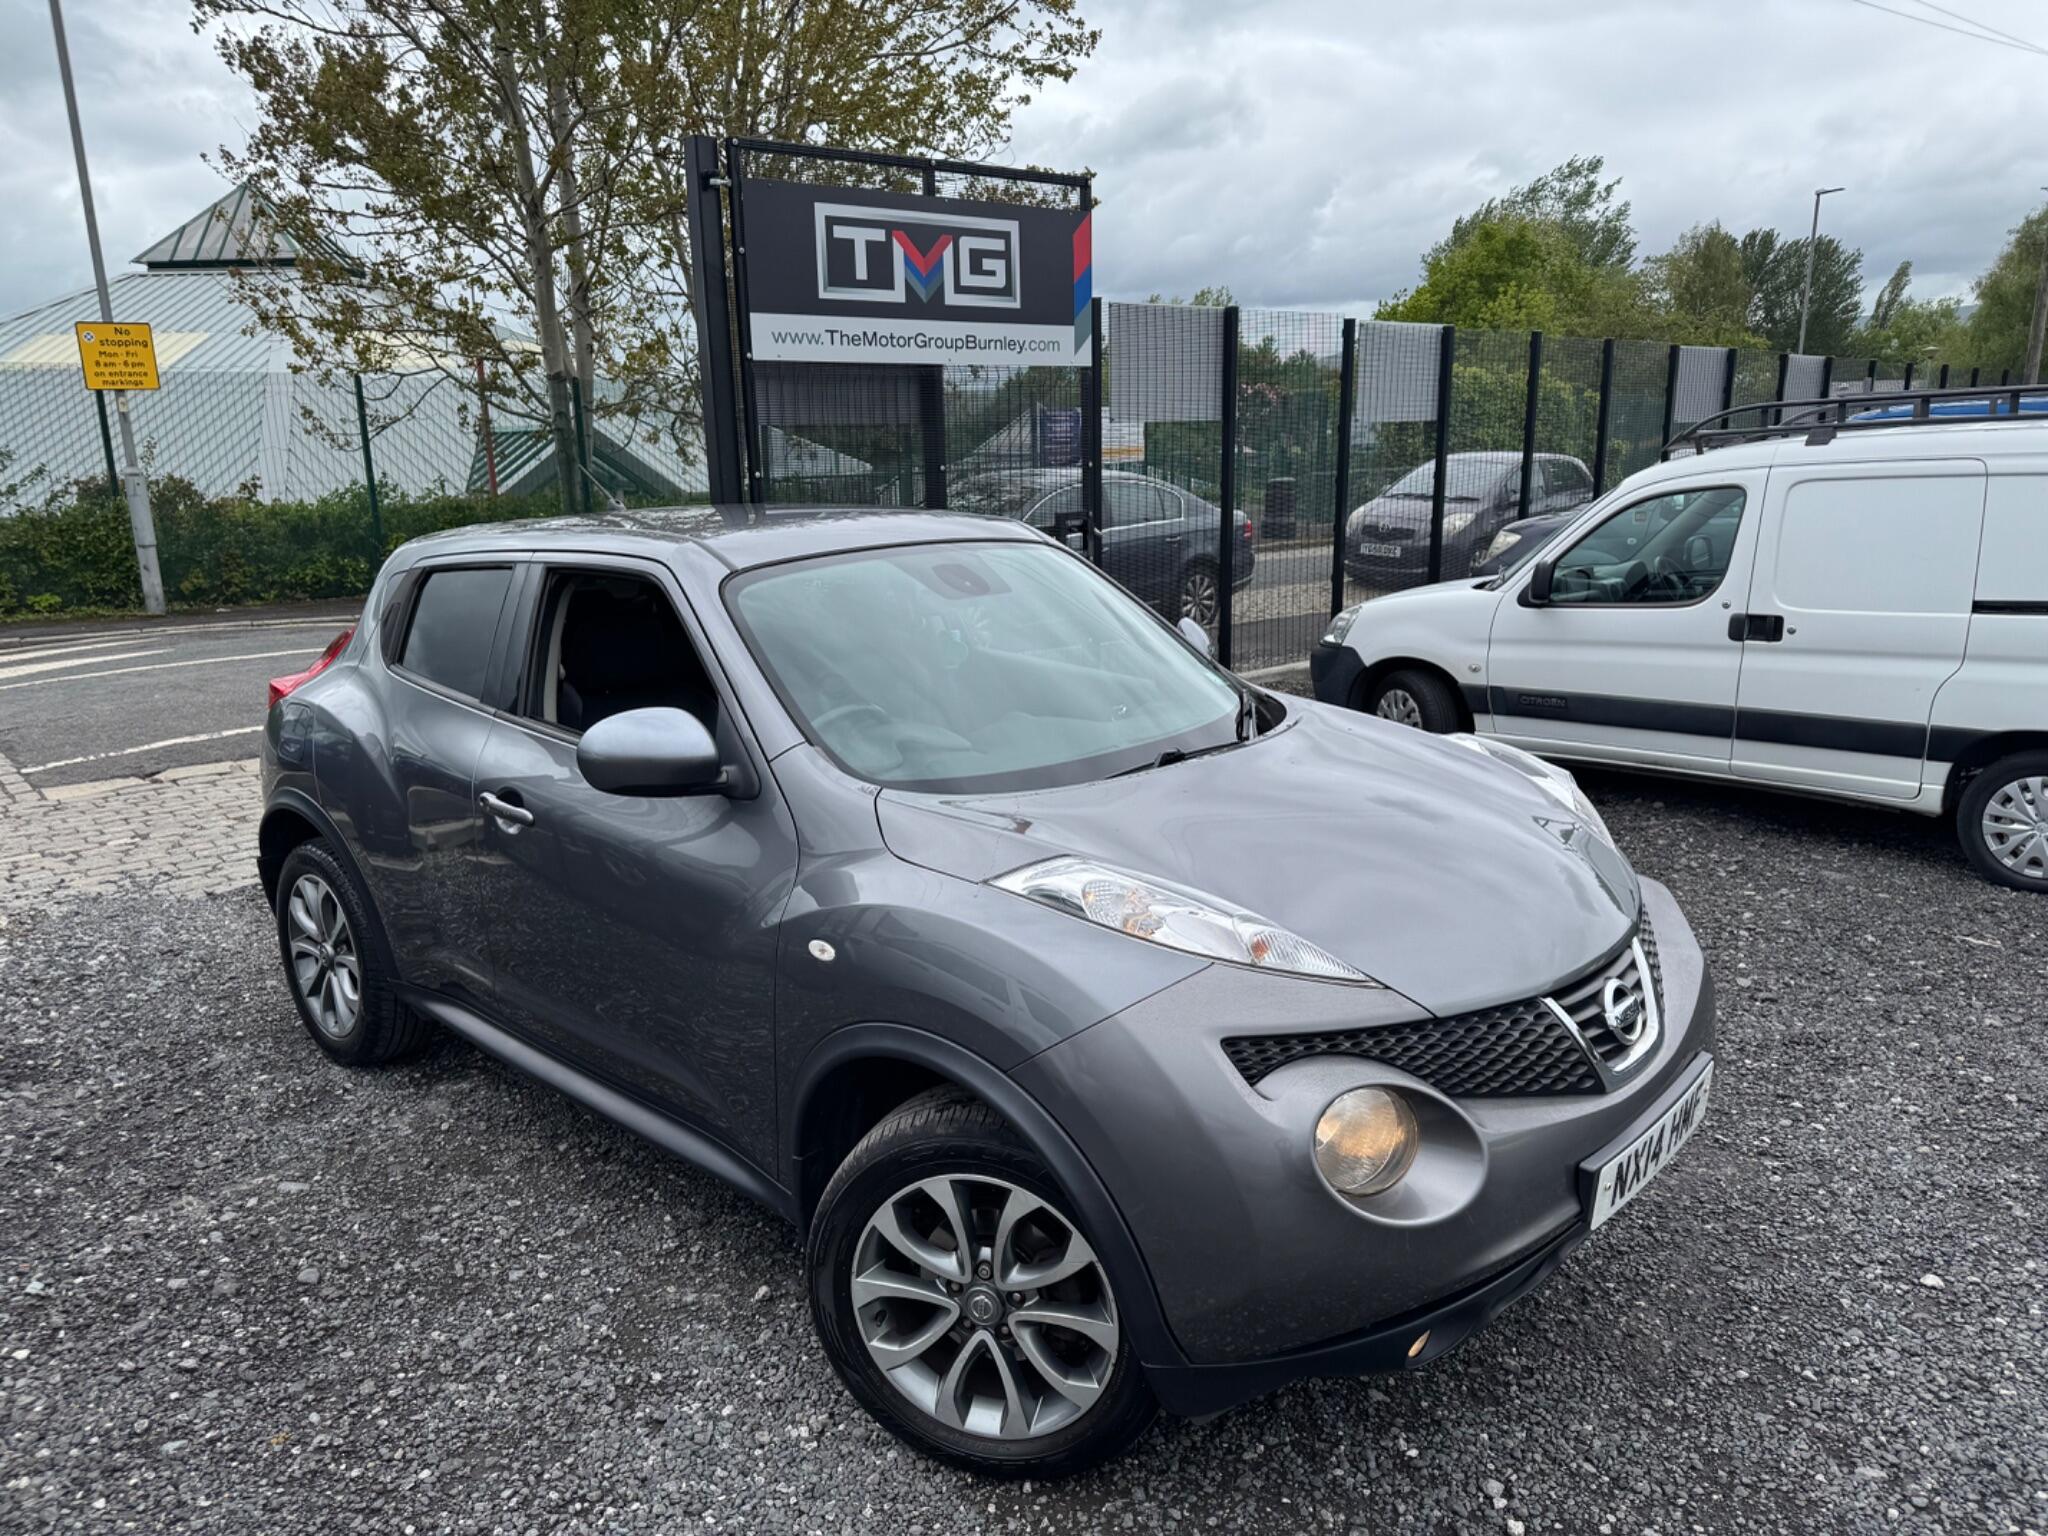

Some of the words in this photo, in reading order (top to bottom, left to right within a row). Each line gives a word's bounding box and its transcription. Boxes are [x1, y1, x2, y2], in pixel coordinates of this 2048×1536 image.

[832, 225, 1006, 303] TMG
[113, 327, 131, 336] No
[99, 338, 148, 348] stopping
[771, 328, 1061, 354] www.TheMotorGroupBurnley.com
[98, 350, 119, 358] Mon
[125, 350, 138, 358] Fri
[131, 361, 145, 369] pm
[102, 379, 144, 387] markings
[1610, 1123, 1666, 1208] NX14
[1667, 1079, 1705, 1155] HMF
